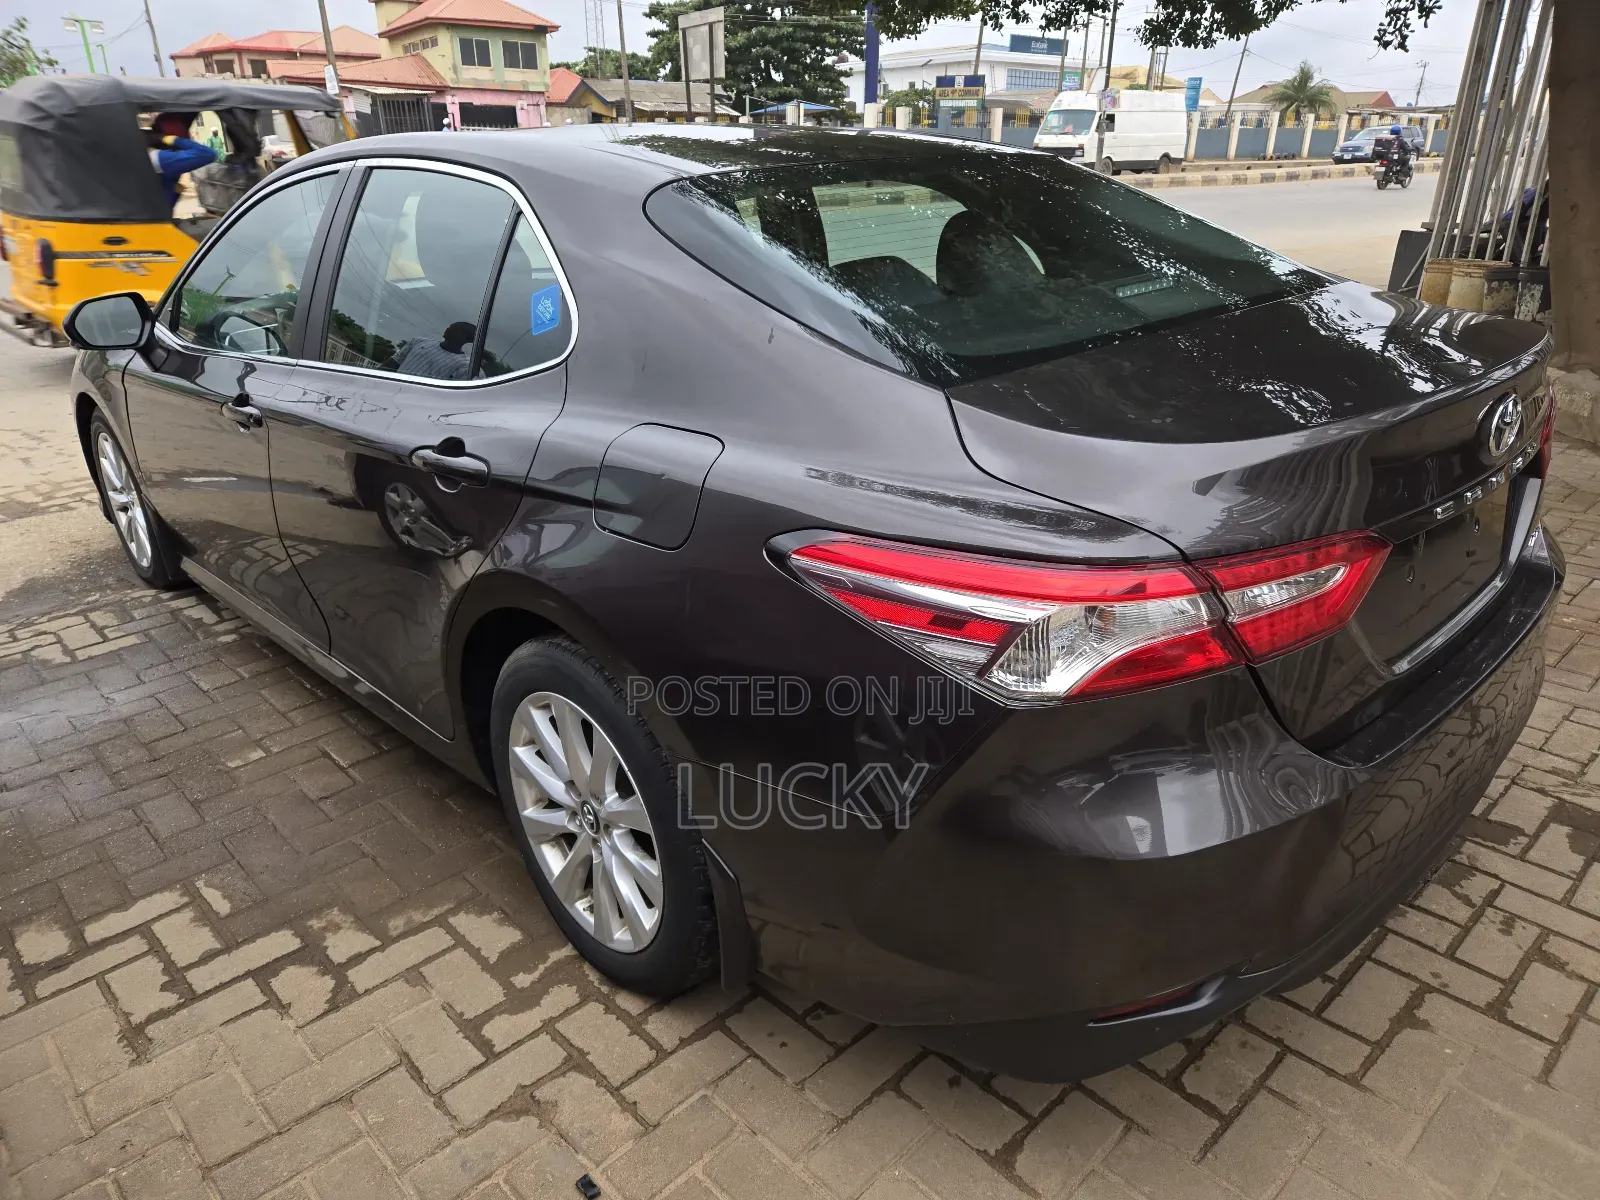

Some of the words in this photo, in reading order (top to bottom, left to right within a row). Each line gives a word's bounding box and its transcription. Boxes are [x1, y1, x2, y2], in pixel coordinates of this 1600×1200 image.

[939, 89, 949, 97] AREA
[958, 88, 980, 97] COMMAND
[939, 99, 977, 107] HEADQUARTERS
